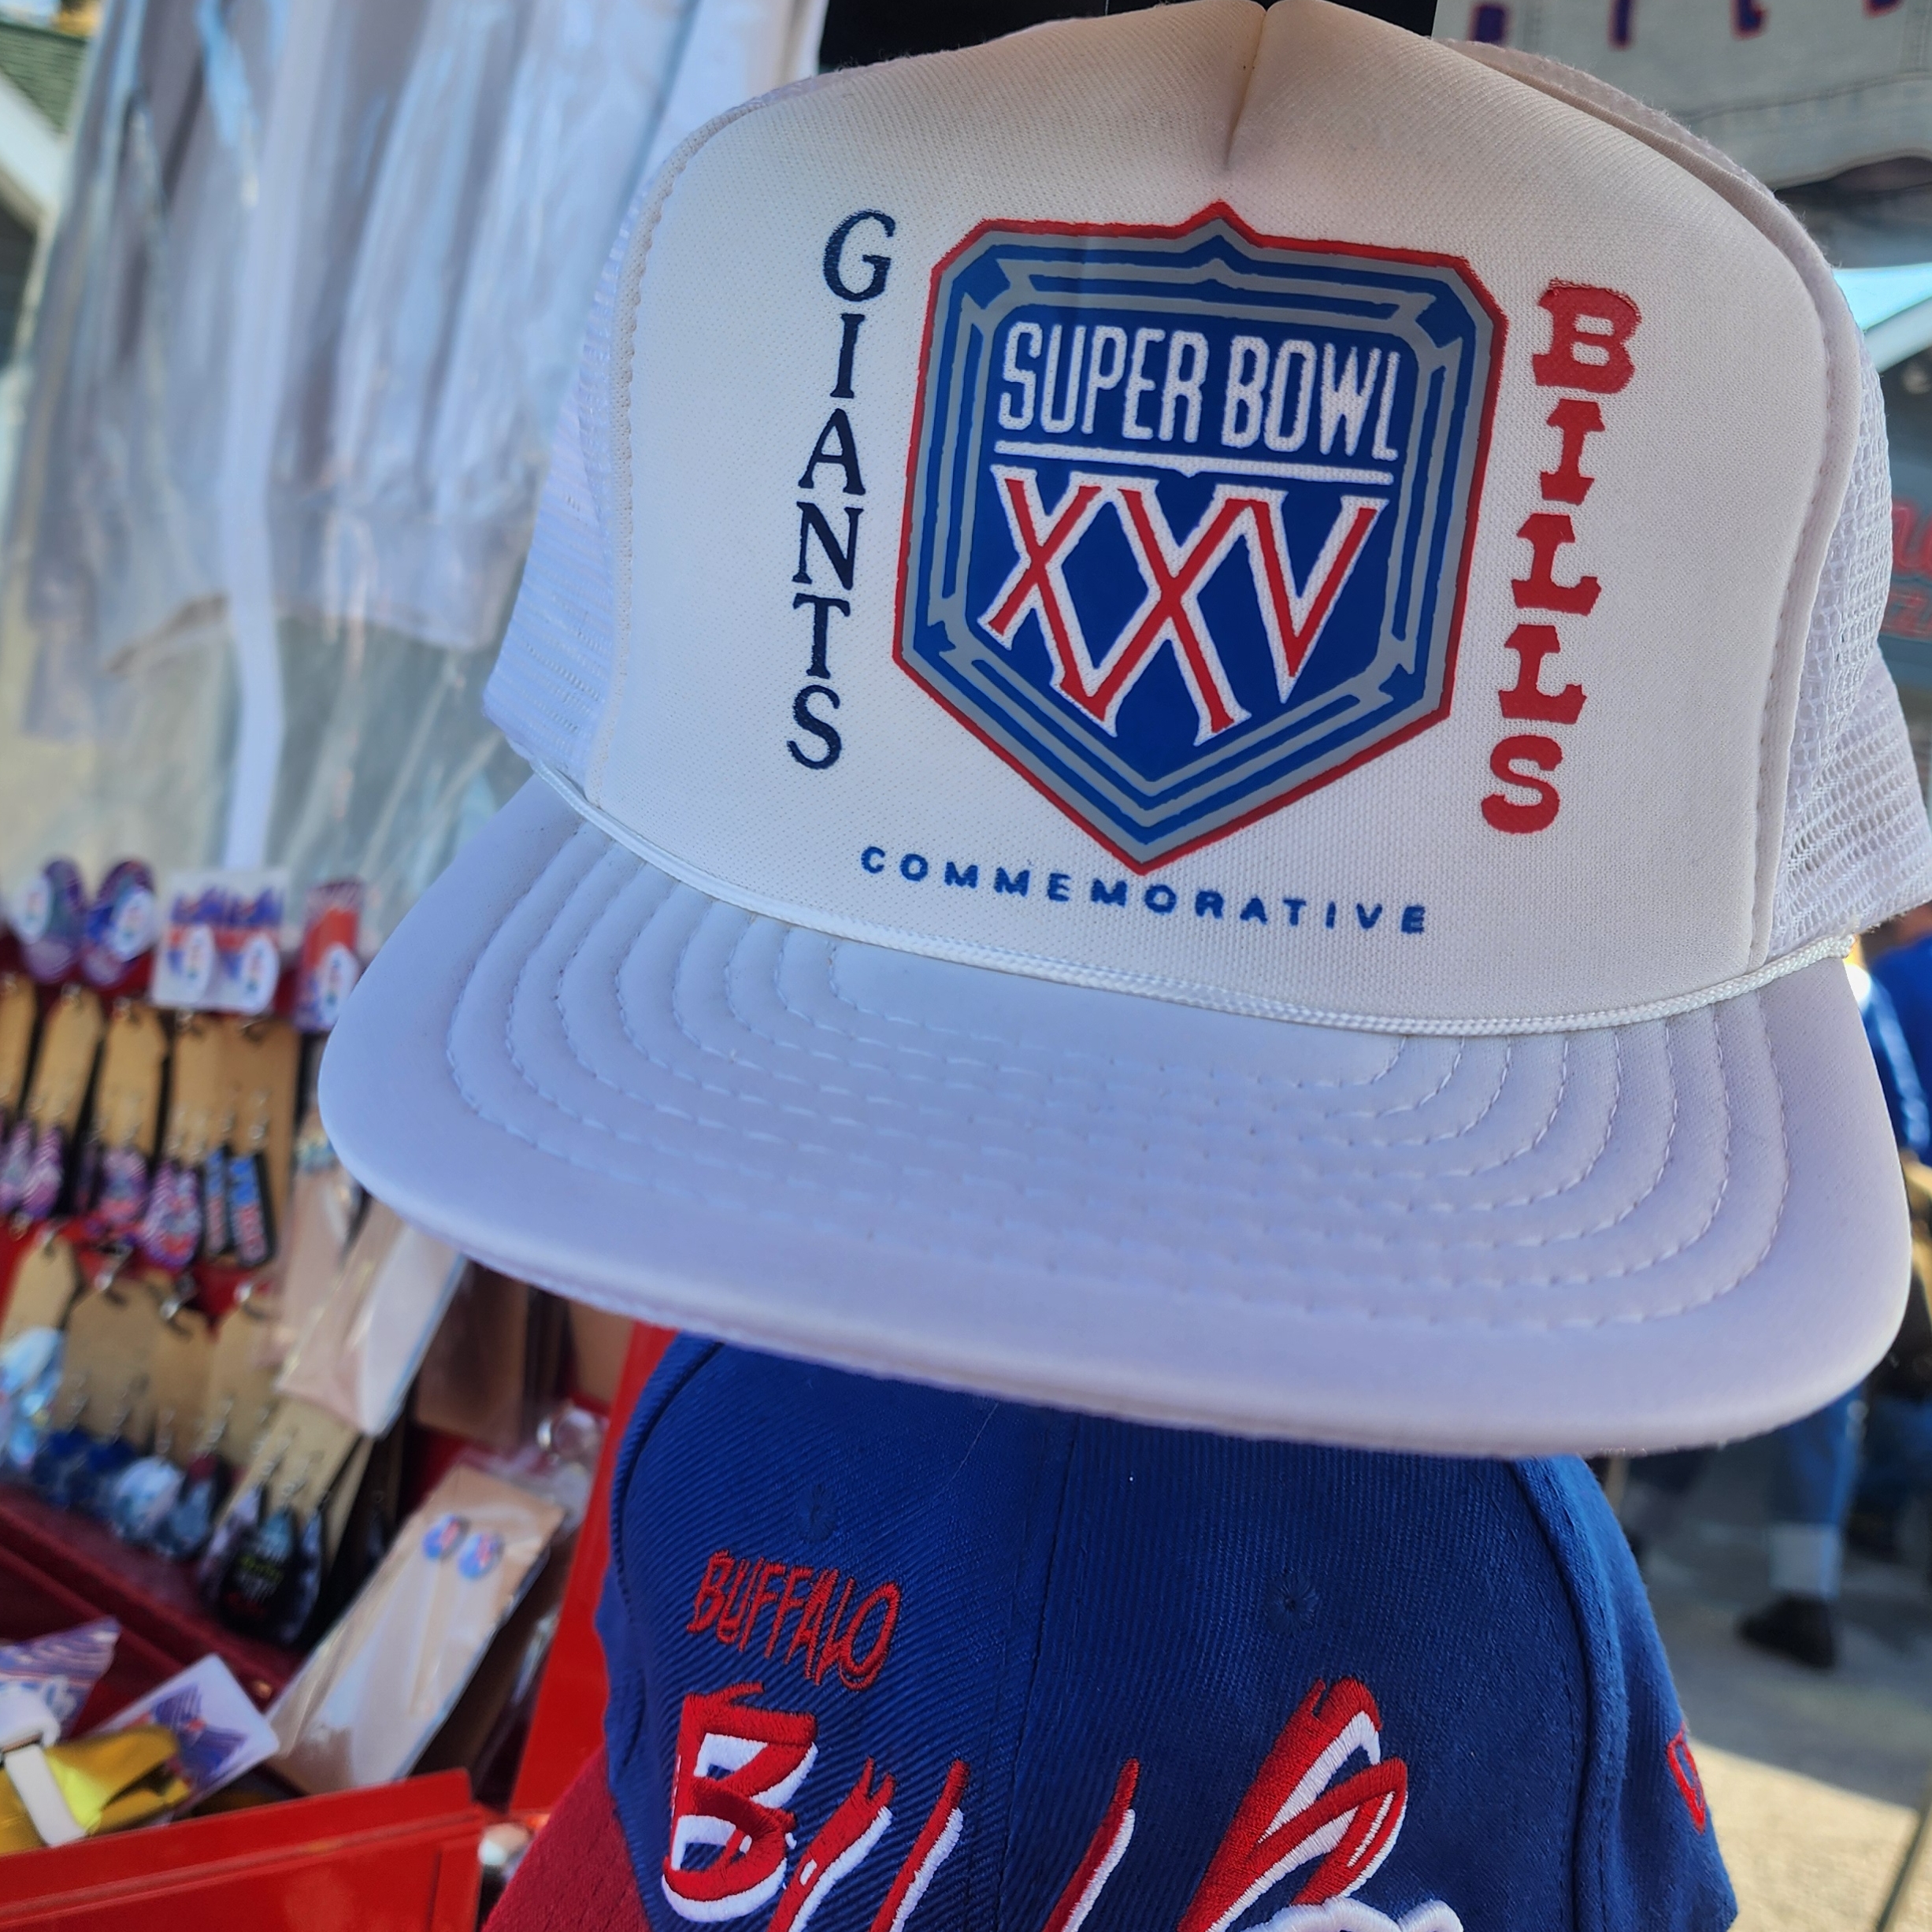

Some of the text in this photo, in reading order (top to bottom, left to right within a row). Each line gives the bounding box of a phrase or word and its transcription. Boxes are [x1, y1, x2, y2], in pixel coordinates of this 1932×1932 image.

[788, 210, 896, 771] GIANTS
[996, 321, 1400, 462] SUPER BOWL
[977, 465, 1389, 747] XXV
[1481, 280, 1641, 834] BILLS
[861, 845, 1427, 936] COMMEMORATIVE
[687, 1549, 901, 1691] BUFFALO
